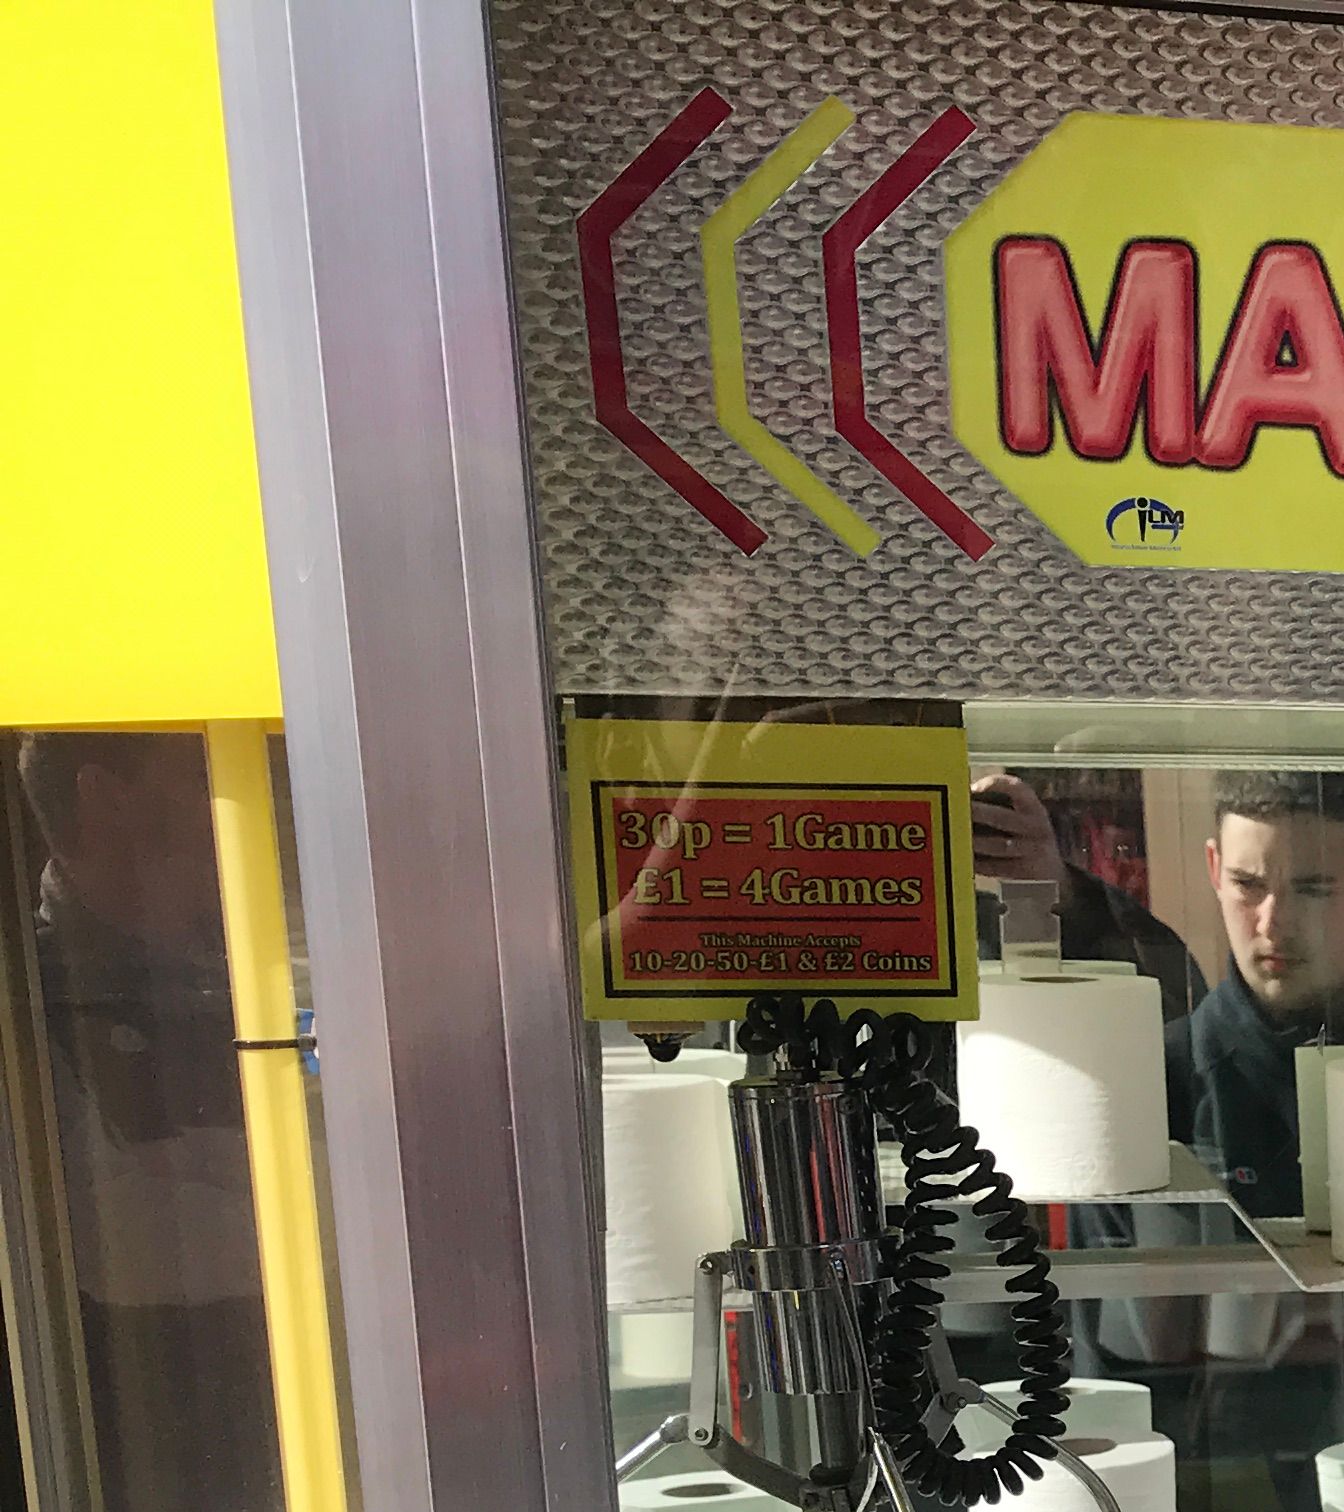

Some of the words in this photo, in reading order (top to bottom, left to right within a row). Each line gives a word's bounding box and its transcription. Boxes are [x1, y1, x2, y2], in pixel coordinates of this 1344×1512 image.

[620, 812, 712, 859] 30p
[724, 823, 753, 844] =
[765, 813, 927, 852] 1Game
[633, 868, 690, 906] £1
[701, 879, 729, 898] =
[740, 868, 923, 906] 4Games
[699, 933, 734, 947] This
[737, 933, 800, 947] Machine
[803, 933, 862, 949] Accepts
[630, 951, 789, 972] 10-20-50-£1
[798, 952, 818, 972] &
[824, 952, 855, 972] £2
[862, 951, 932, 973] Coins
